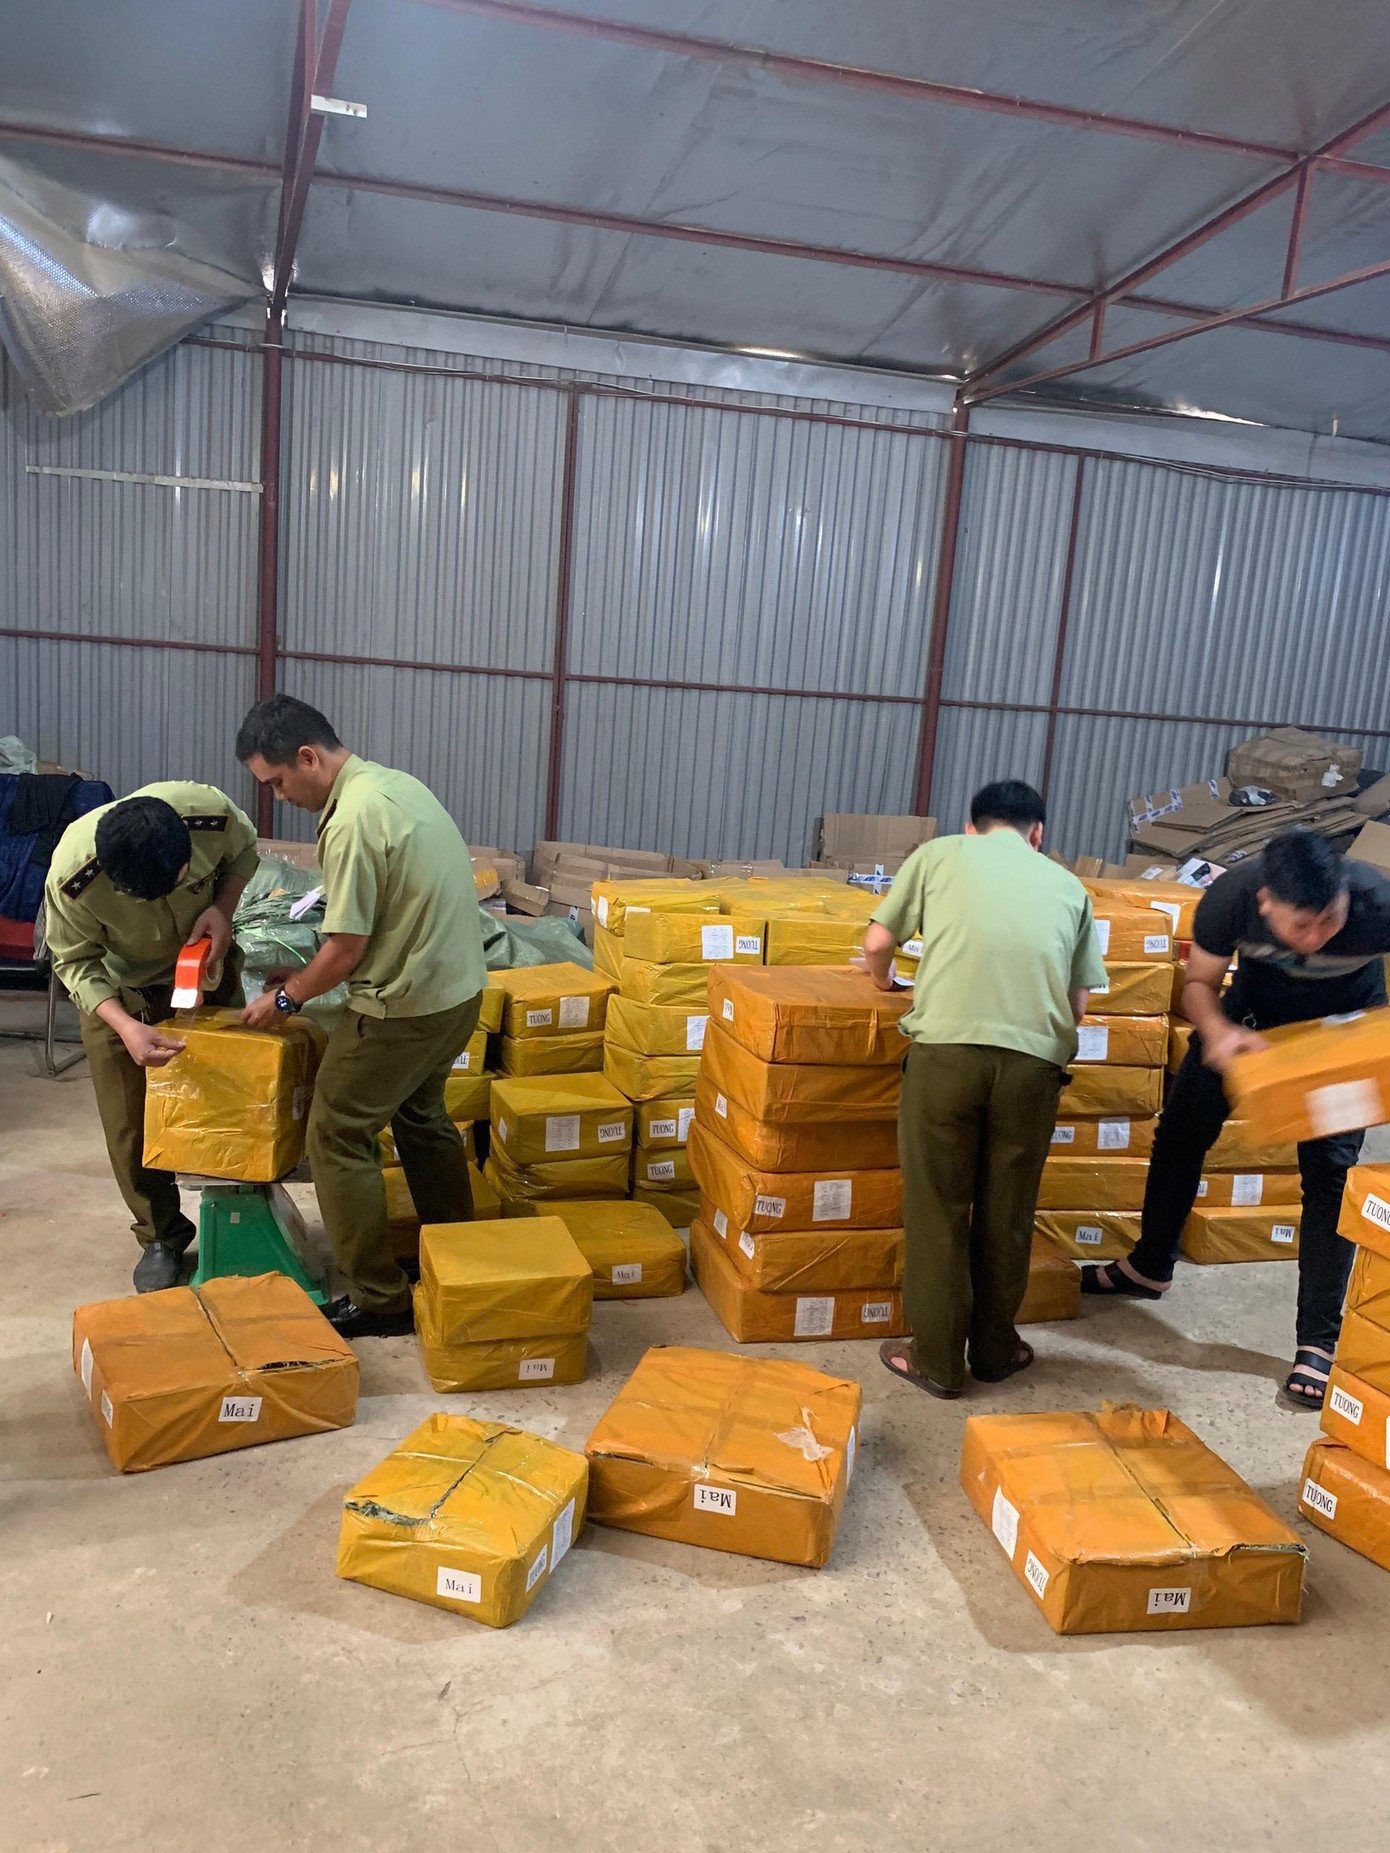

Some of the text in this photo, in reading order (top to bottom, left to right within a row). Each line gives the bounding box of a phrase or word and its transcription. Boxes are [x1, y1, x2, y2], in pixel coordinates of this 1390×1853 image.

[529, 1013, 551, 1025] TUONG
[599, 1126, 622, 1139] TUONG
[651, 1123, 674, 1135] TUONG
[649, 1164, 673, 1176] TUONG
[756, 1200, 783, 1215] TUONG
[1077, 1230, 1100, 1241] Mai
[1274, 1227, 1293, 1239] Mai
[223, 1403, 255, 1418] Mai
[1334, 1392, 1360, 1419] TUONG
[699, 1488, 732, 1509] Mai
[1306, 1485, 1333, 1513] TUONG
[445, 1578, 473, 1594] Mai
[1154, 1592, 1187, 1607] Mai
